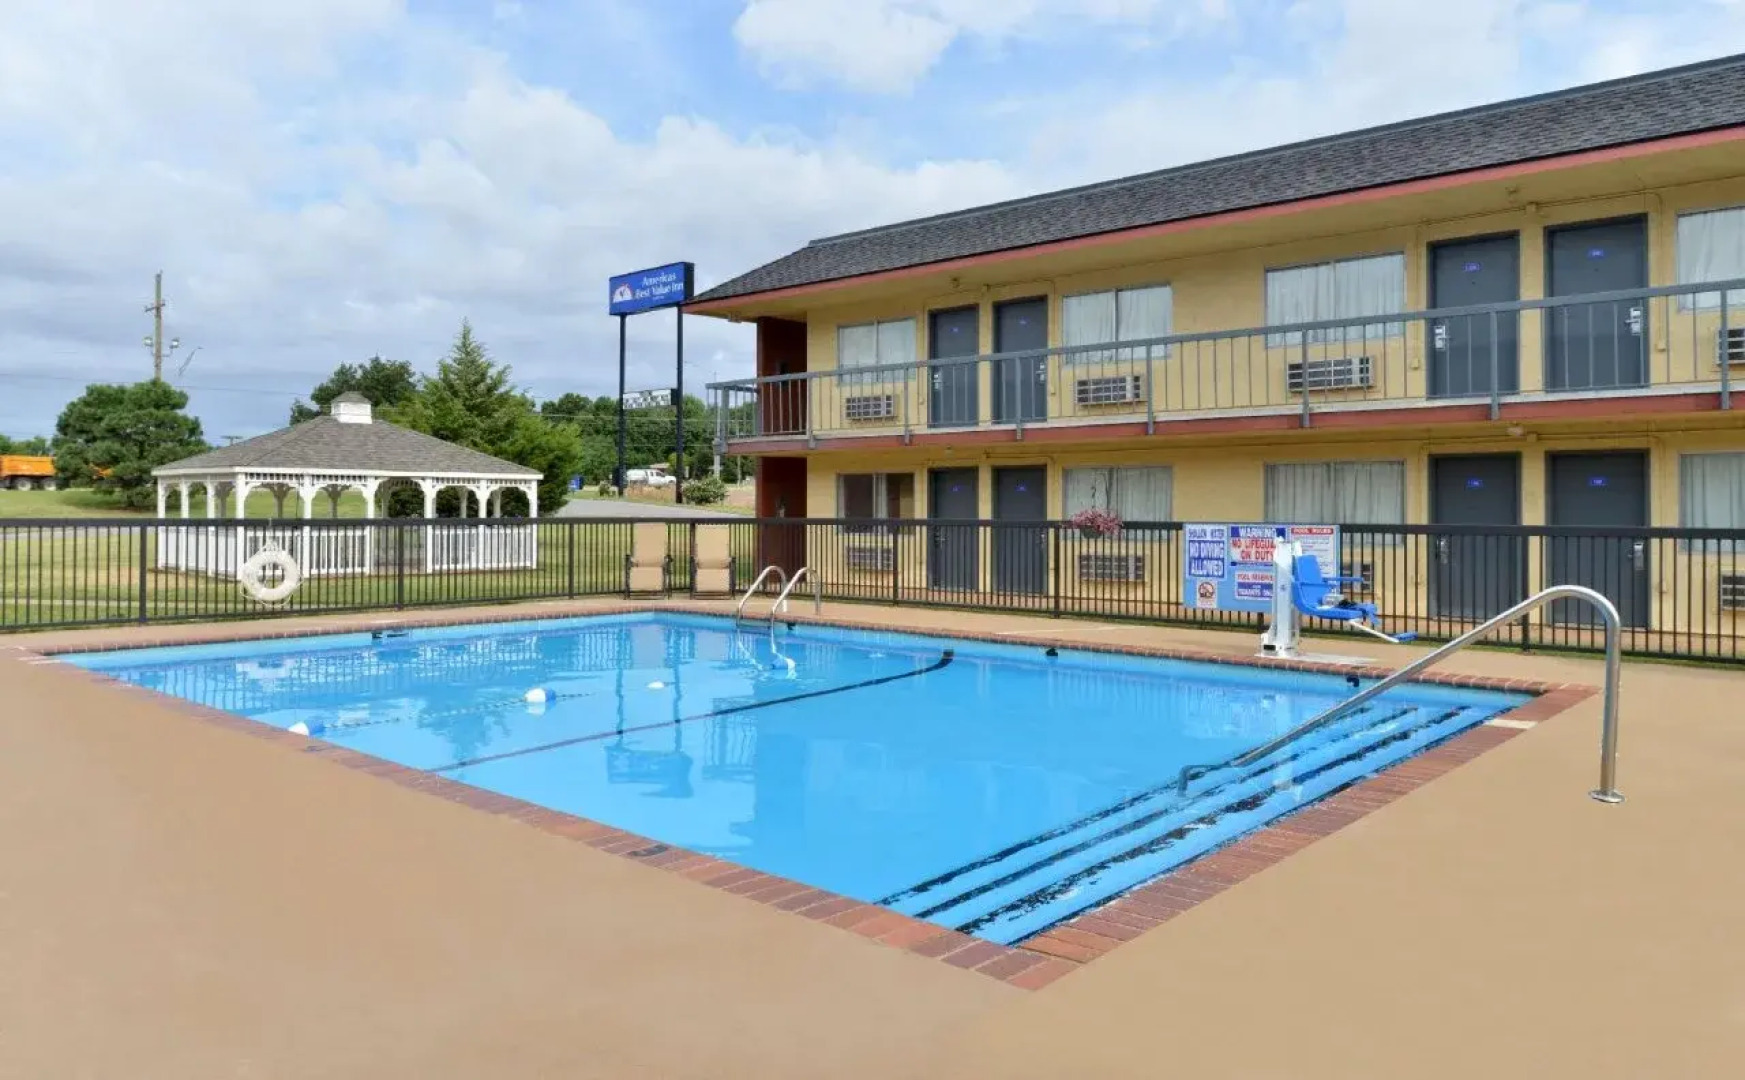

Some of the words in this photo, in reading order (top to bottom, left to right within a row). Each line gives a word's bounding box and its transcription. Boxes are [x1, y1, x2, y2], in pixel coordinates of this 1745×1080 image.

[652, 283, 671, 295] Value
[672, 281, 684, 292] Inn
[1239, 527, 1276, 538] WARNING
[1189, 542, 1199, 558] NO
[1200, 542, 1224, 559] DIVING
[1232, 539, 1241, 549] NO
[1190, 559, 1224, 576] ALLOWED
